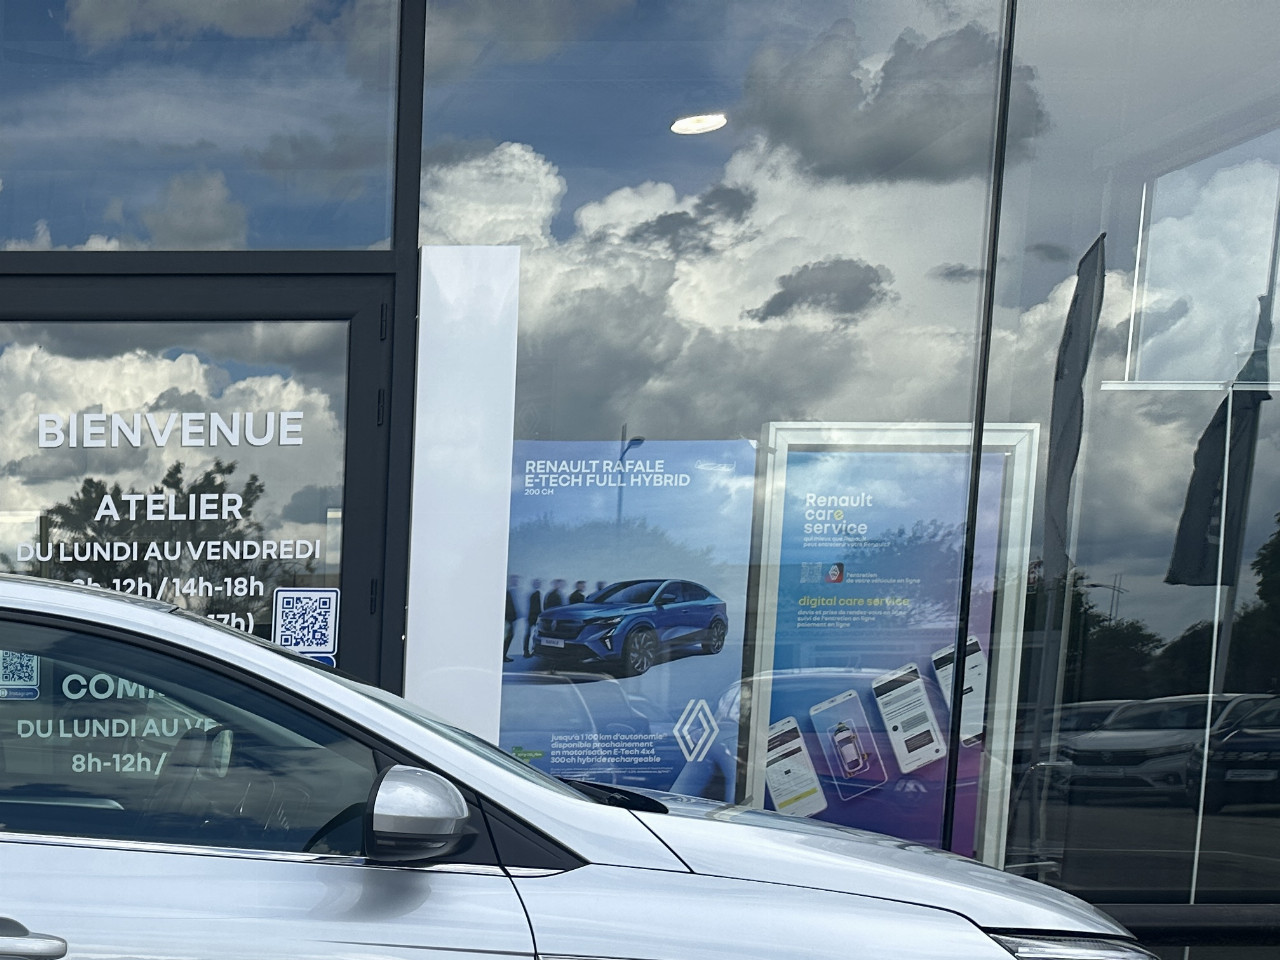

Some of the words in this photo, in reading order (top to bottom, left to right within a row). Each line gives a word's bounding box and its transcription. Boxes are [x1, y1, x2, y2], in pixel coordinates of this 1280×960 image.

[37, 411, 304, 448] BIENVENUE
[525, 459, 600, 473] RENAULT
[602, 459, 665, 473] RAFALE
[524, 474, 583, 488] E-TECH
[585, 474, 627, 488] FULL
[630, 473, 691, 488] HYBRID
[524, 488, 541, 496] 200
[541, 488, 554, 496] CH
[805, 492, 873, 507] Renault
[93, 493, 244, 522] ATELIER
[804, 509, 844, 521] care
[803, 520, 868, 535] service
[16, 541, 53, 562] DU
[59, 541, 138, 562] LUNDI
[143, 541, 181, 561] AU
[185, 539, 321, 561] VENDREDI
[172, 576, 264, 597] 14h-18h
[798, 595, 837, 608] digital
[838, 597, 865, 606] care
[866, 595, 910, 606] service
[17, 718, 53, 738] DU
[59, 718, 136, 738] LUNDI
[142, 718, 178, 737] AU
[550, 740, 592, 749] disponible
[592, 740, 654, 749] prochainement
[551, 733, 580, 742] jusqu'à
[599, 733, 612, 741] km
[561, 748, 613, 756] motorisation
[71, 753, 151, 773] 8h-12h
[576, 756, 607, 765] hybride
[607, 756, 662, 764] rechargeable
